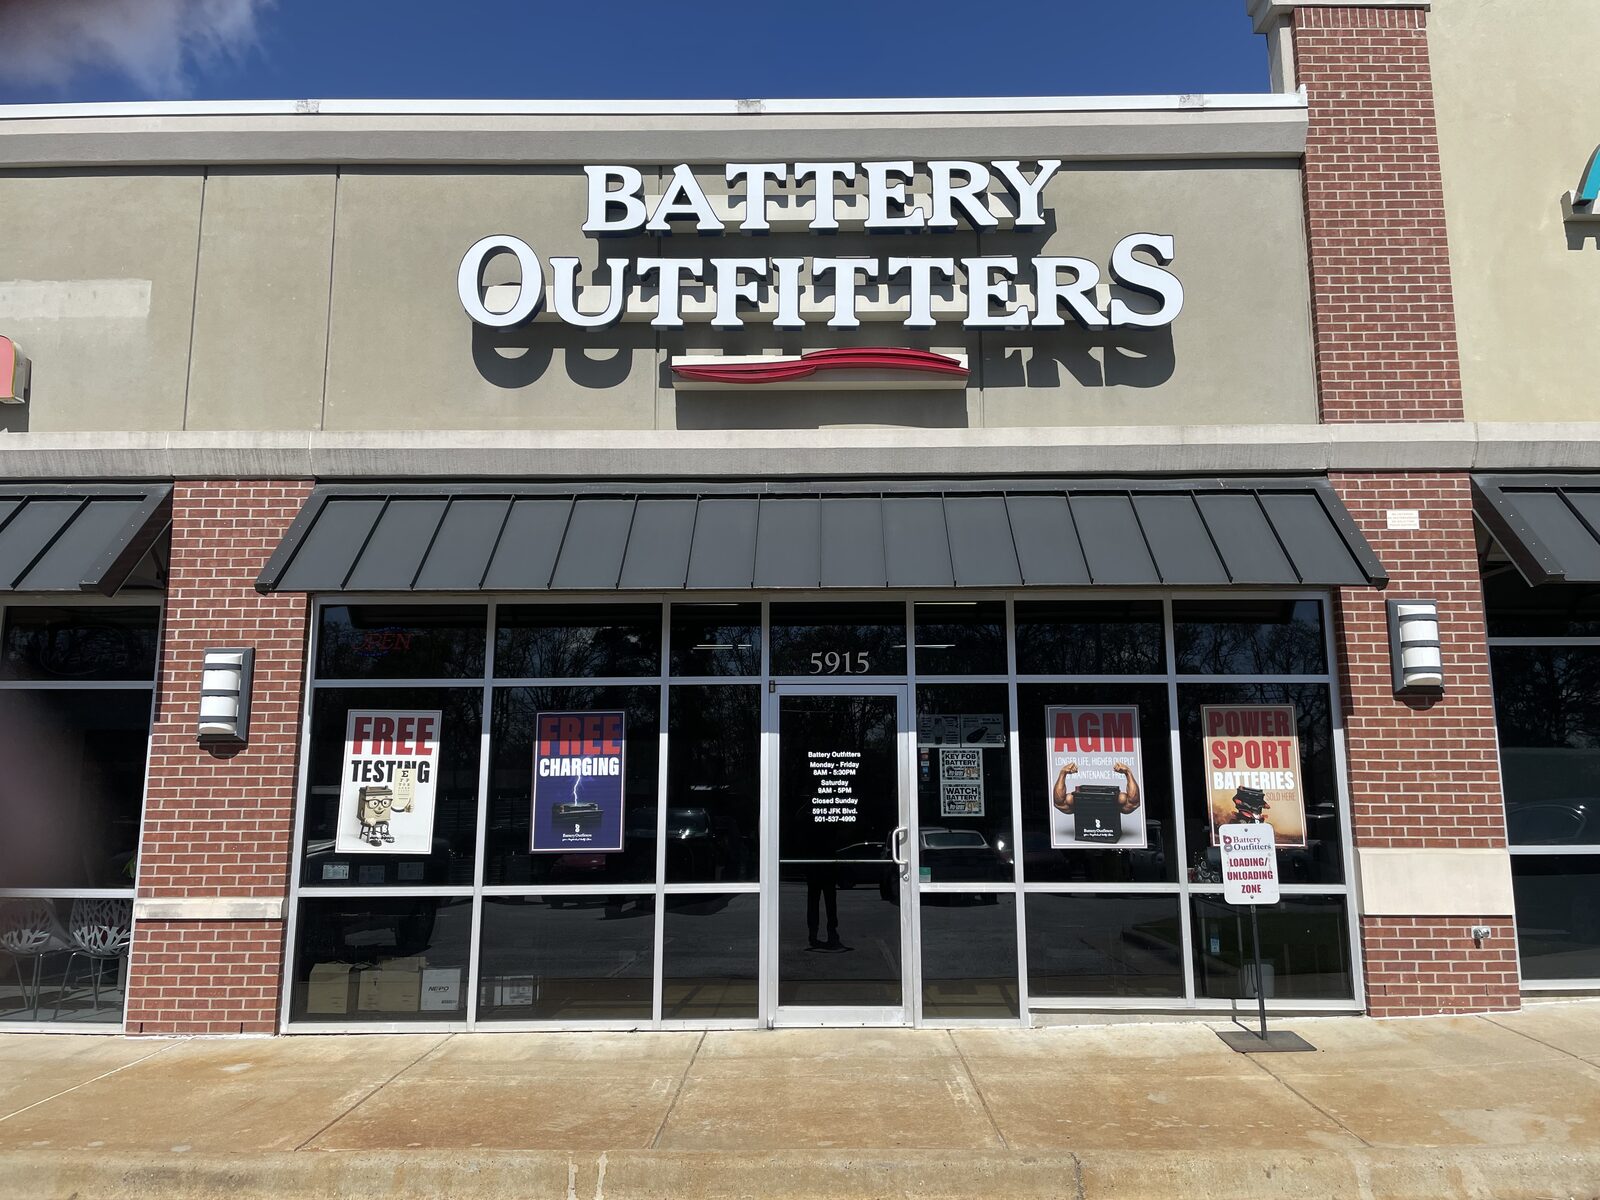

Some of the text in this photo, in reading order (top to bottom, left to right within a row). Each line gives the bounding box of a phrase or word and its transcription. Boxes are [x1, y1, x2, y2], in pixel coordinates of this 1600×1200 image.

[582, 160, 1061, 234] BATTERY
[457, 232, 1184, 328] OUTFITTERS
[809, 651, 870, 674] 5915
[1054, 712, 1134, 753] AGM
[1209, 711, 1290, 737] POWER
[352, 717, 434, 756] FREE
[540, 716, 621, 756] FREE
[1092, 757, 1113, 766] HIGHER
[1211, 740, 1291, 769] SPORT
[540, 757, 619, 777] CHARGING
[1213, 771, 1295, 790] BATTERIES
[1266, 791, 1296, 801] SOLD HERE
[1233, 842, 1272, 851] Outfitters
[1229, 857, 1268, 867] LOADING/
[1227, 870, 1273, 880] UNLOADING
[1241, 884, 1262, 893] ZONE
